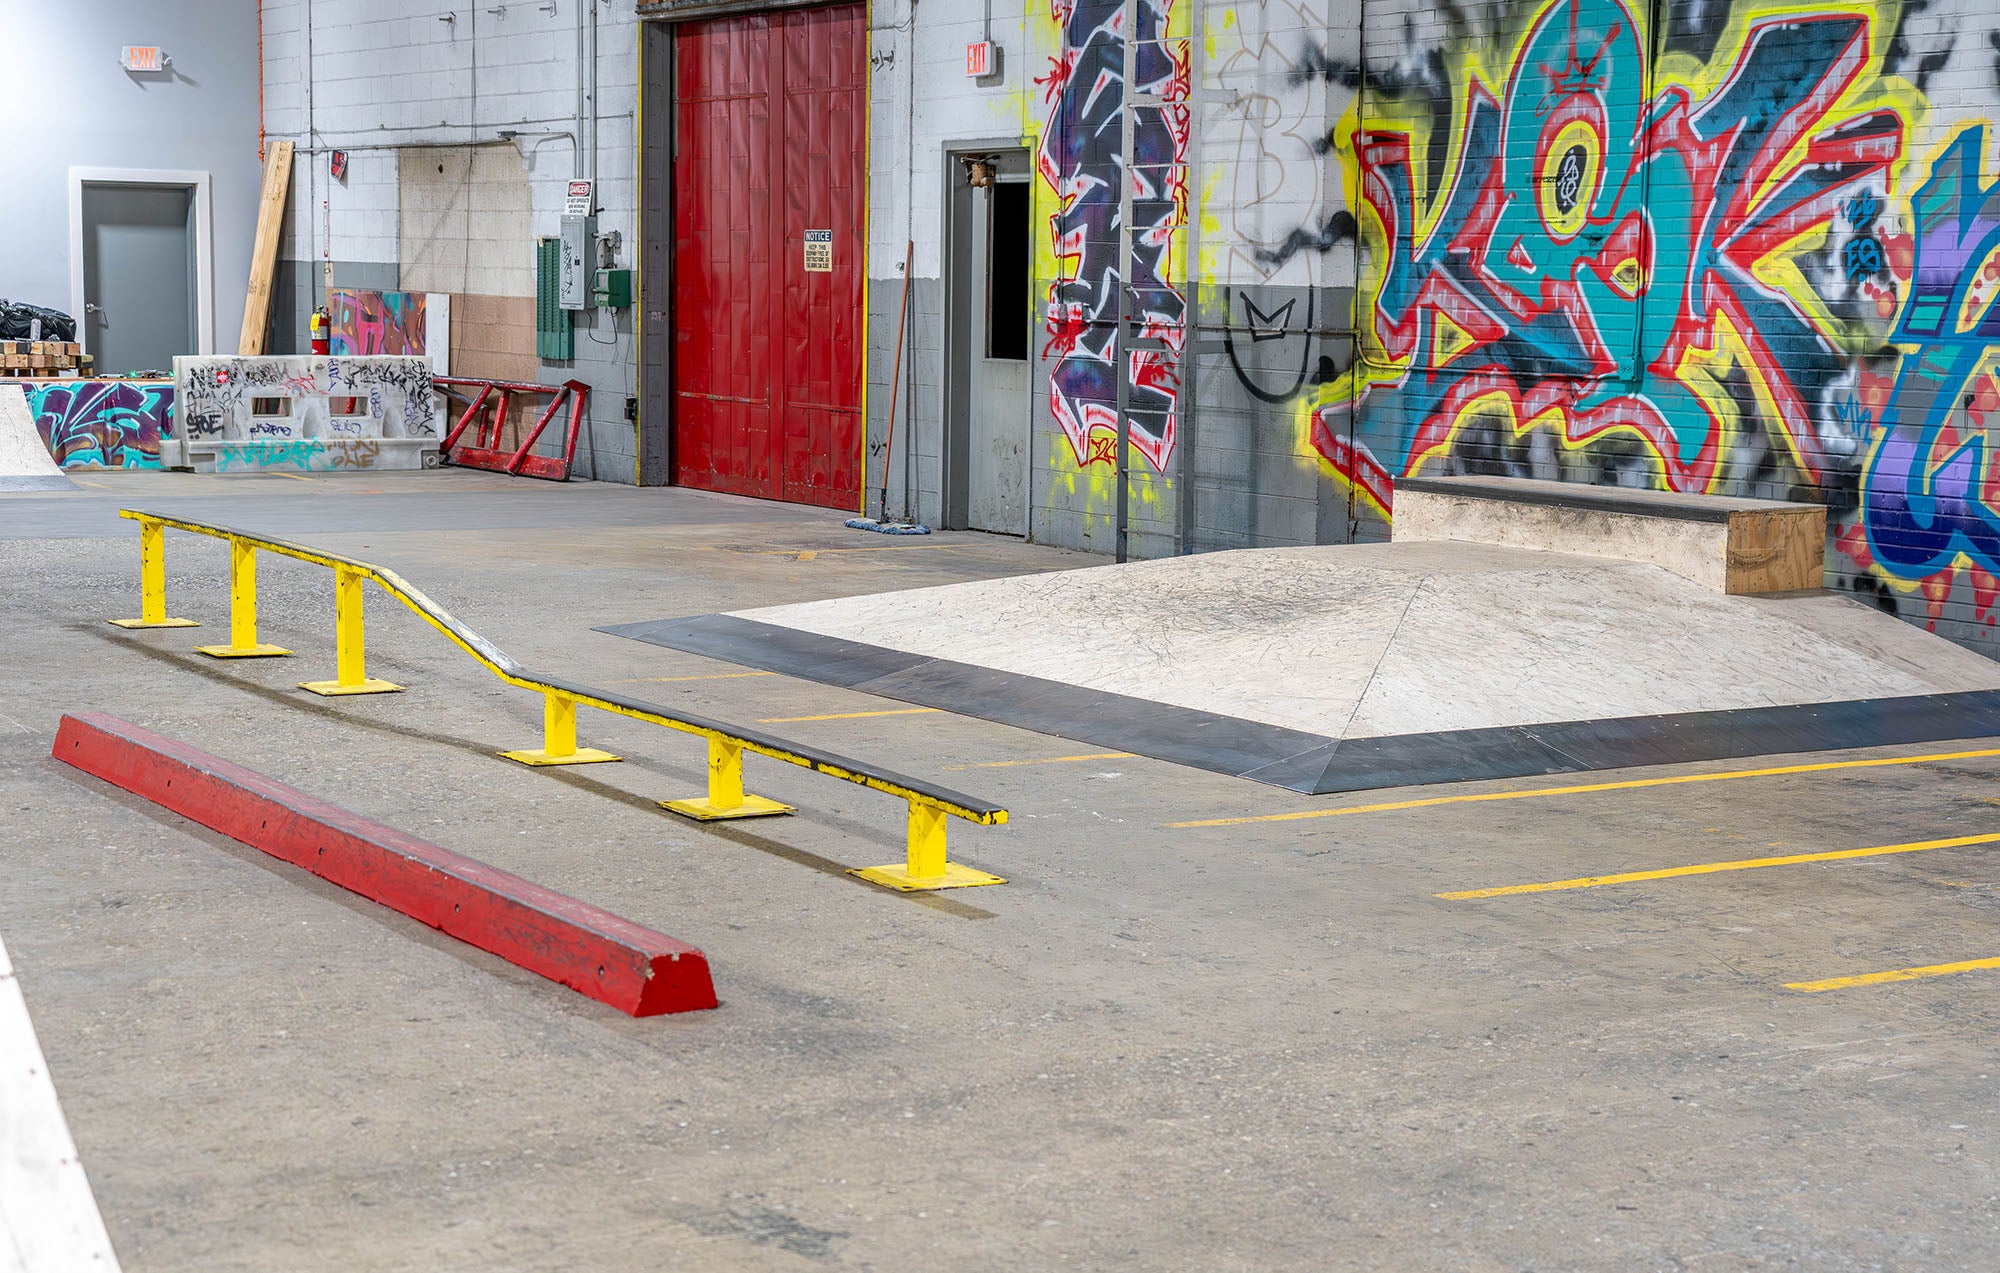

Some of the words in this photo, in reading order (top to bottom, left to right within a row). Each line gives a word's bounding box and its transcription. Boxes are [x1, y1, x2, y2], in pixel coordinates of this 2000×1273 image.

[130, 47, 156, 69] EXIT
[967, 42, 987, 75] EXIT
[570, 185, 590, 194] DANGER
[805, 232, 830, 241] NOTICE
